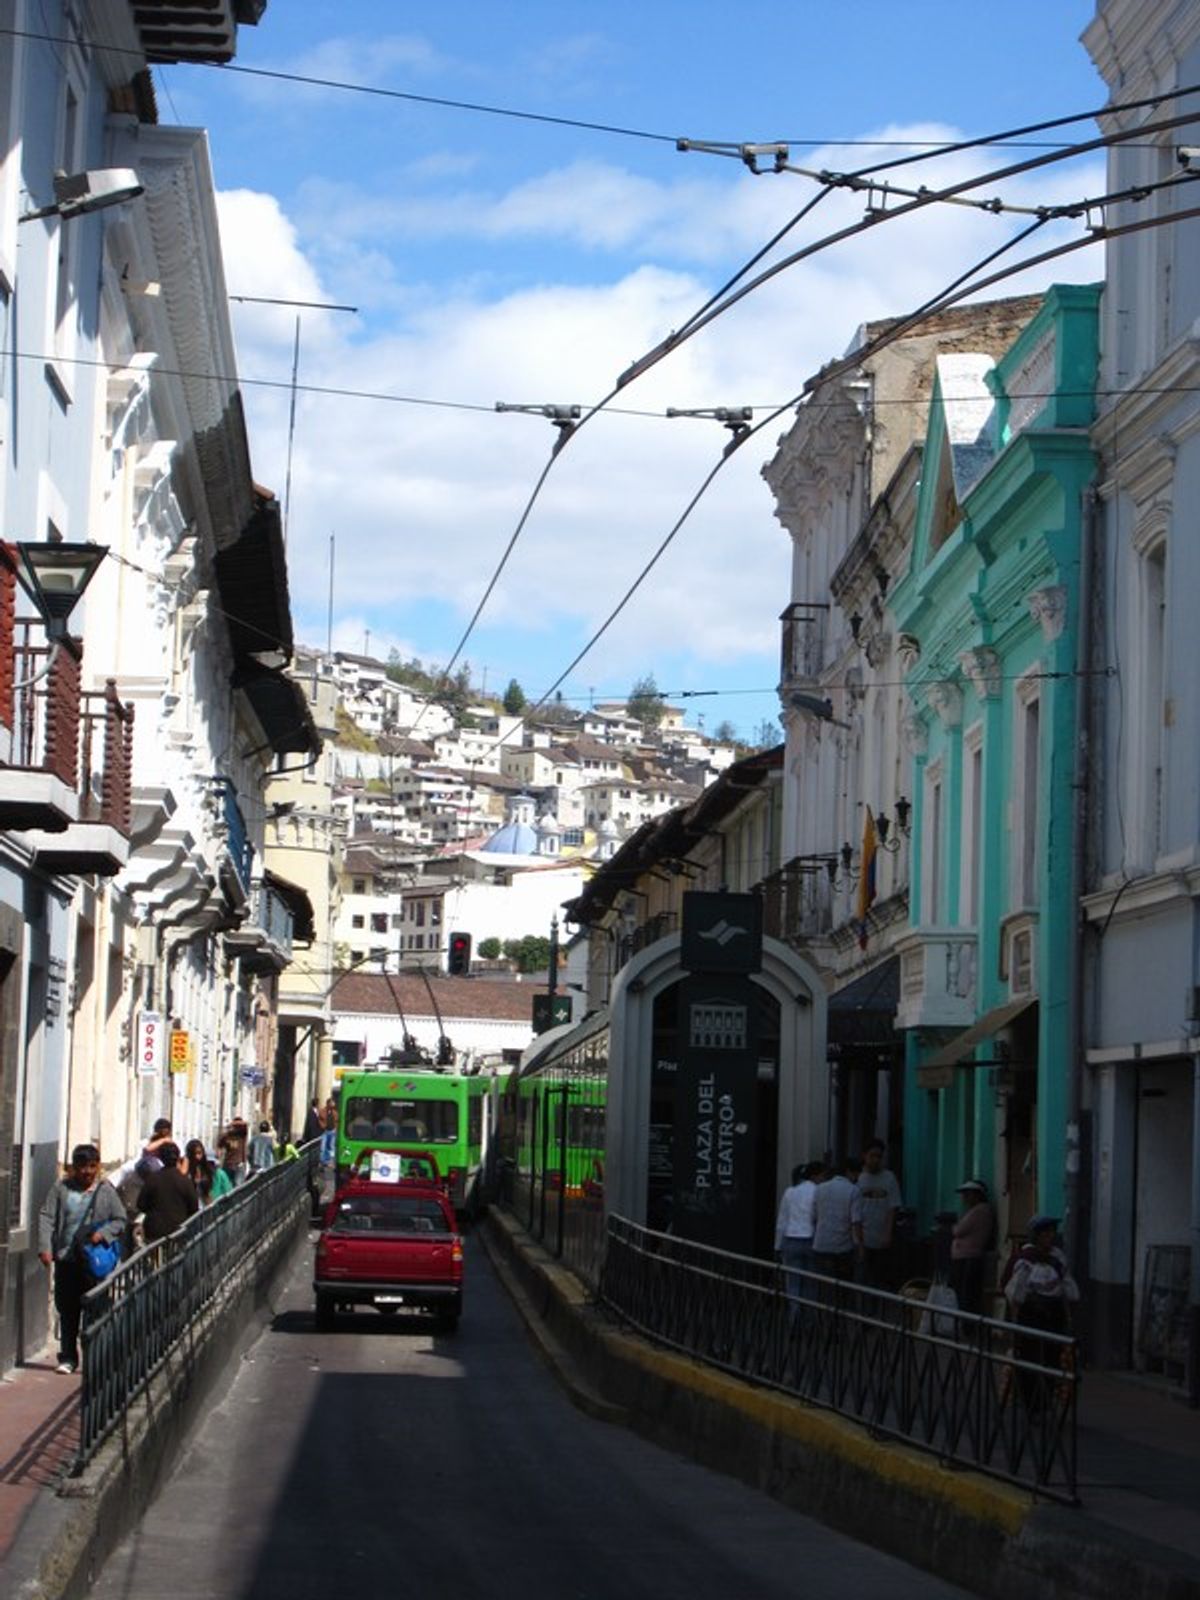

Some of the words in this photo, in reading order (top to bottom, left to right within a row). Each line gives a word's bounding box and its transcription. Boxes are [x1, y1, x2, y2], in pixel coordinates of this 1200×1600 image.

[144, 1023, 155, 1062] ORO
[698, 1073, 715, 1114] DEL
[696, 1120, 713, 1188] PLAZA
